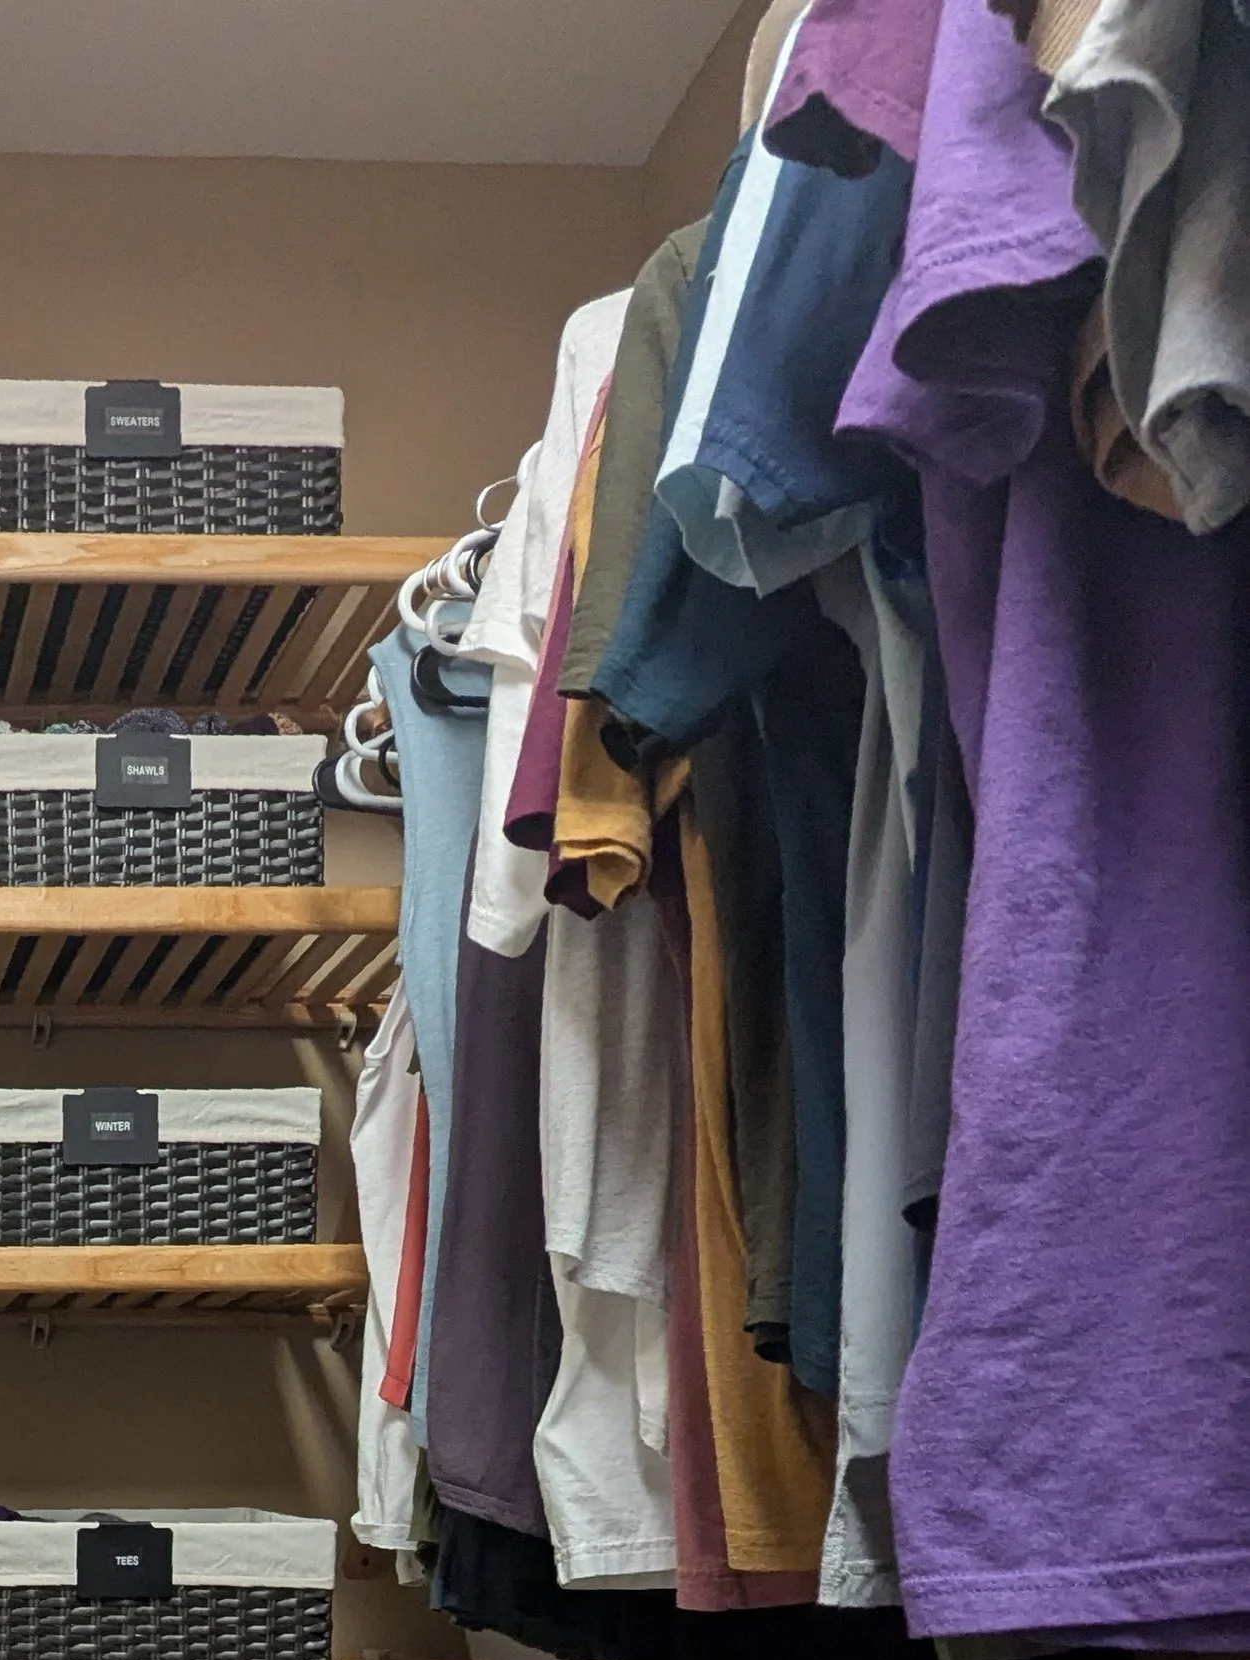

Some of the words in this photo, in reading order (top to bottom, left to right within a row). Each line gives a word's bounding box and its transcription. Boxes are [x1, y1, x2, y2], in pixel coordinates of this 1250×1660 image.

[110, 416, 160, 427] SWEATERS
[127, 765, 165, 776] SHAWLS
[95, 1121, 131, 1132] WINTER
[115, 1556, 139, 1566] TEES
